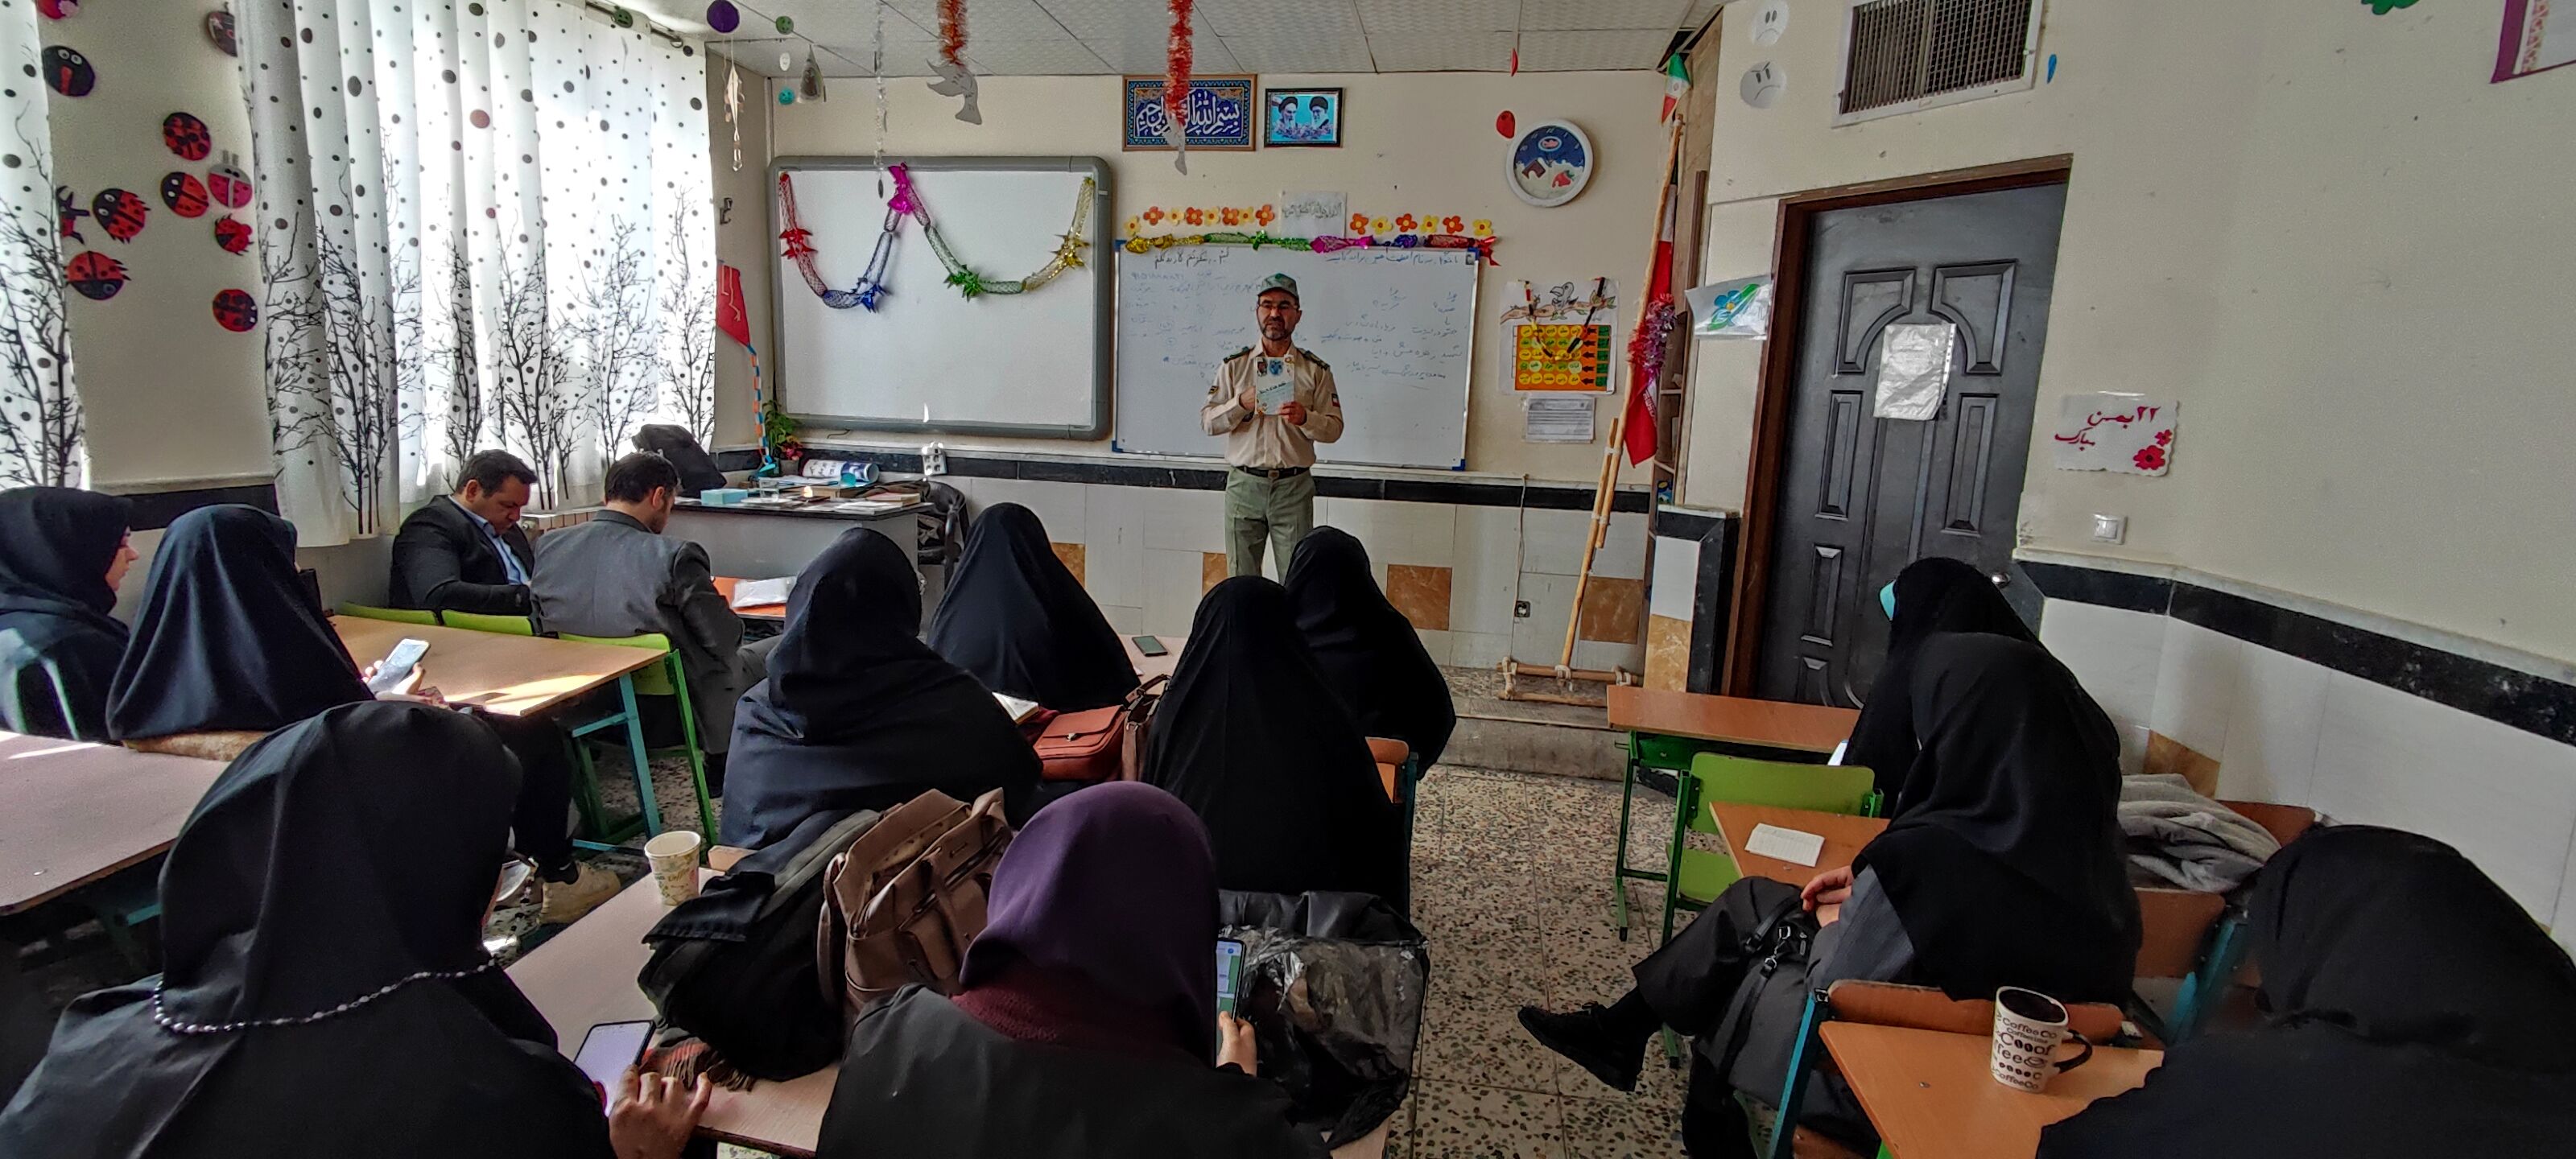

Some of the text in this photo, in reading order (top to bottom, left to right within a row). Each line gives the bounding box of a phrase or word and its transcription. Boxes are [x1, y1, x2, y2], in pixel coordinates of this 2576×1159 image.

[2087, 406, 2161, 429] ۲۲ بهمن
[2054, 427, 2096, 452] مبارک
